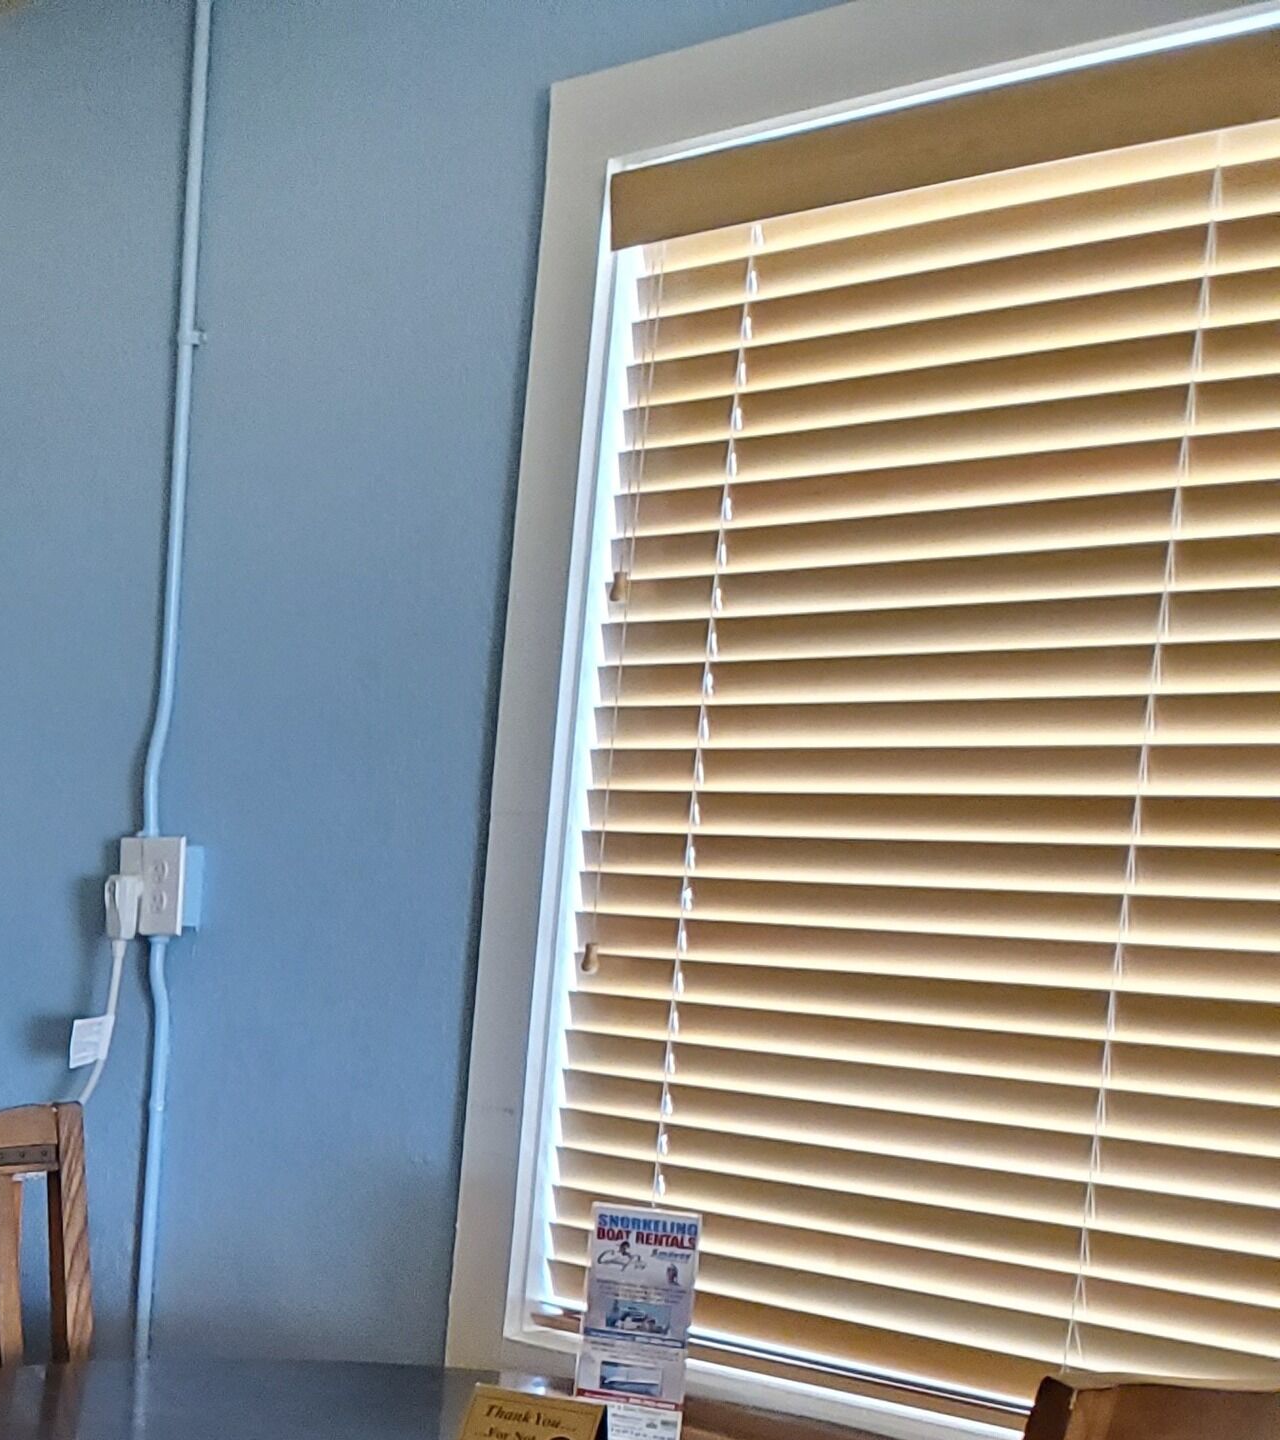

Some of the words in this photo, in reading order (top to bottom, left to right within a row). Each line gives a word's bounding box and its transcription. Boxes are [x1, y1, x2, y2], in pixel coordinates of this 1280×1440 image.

[598, 1213, 698, 1236] SNORKELING
[597, 1227, 632, 1242] BOAT
[635, 1231, 697, 1251] RENTALS
[485, 1404, 532, 1423] Thank
